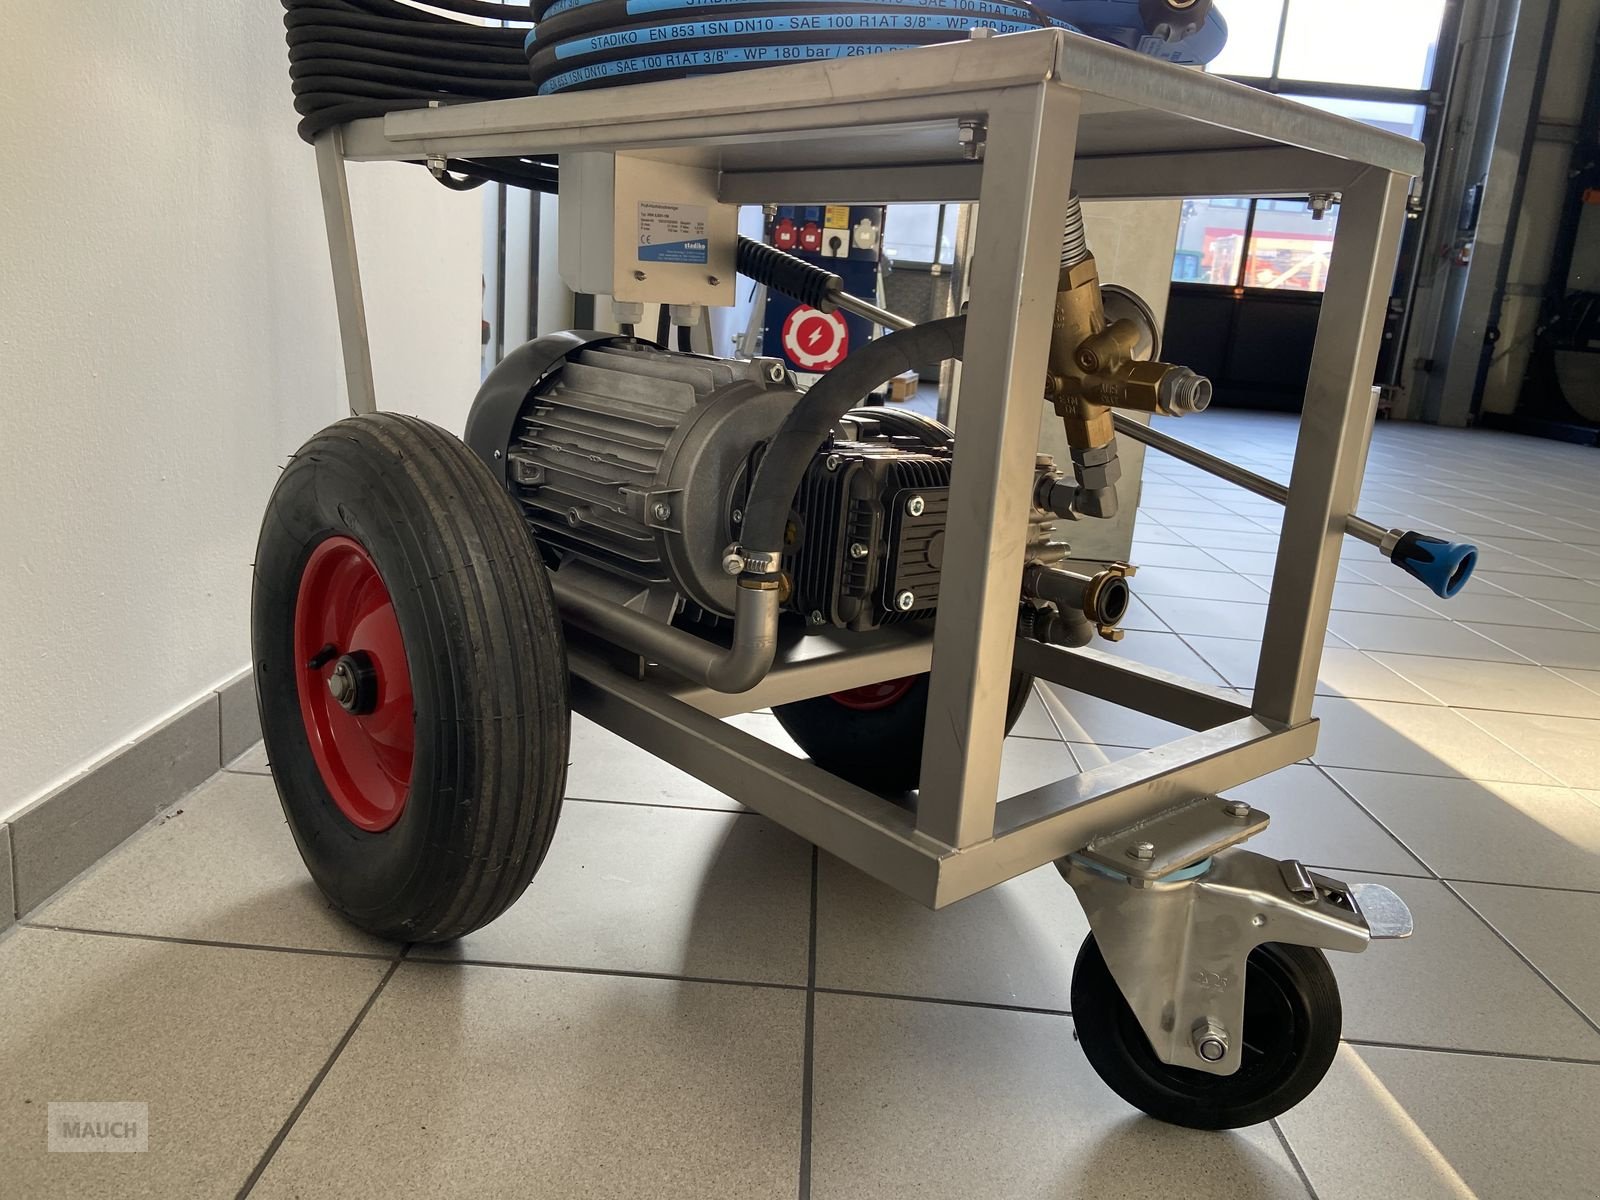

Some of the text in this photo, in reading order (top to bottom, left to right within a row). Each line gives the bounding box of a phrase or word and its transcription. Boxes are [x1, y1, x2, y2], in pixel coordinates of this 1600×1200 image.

[980, 4, 1008, 15] R1AT
[590, 31, 638, 50] STADIKO
[649, 28, 667, 41] EN
[671, 25, 695, 38] 853
[700, 22, 729, 35] 1SN
[734, 19, 774, 32] DN10
[790, 17, 820, 29] SAE
[827, 16, 854, 28] 100
[860, 15, 899, 28] R1AT
[904, 16, 932, 29] 3/8"
[946, 17, 968, 29] WP
[1000, 22, 1020, 34] bar
[584, 64, 607, 79] DN10
[617, 60, 639, 73] SAE
[643, 56, 661, 69] 100
[666, 52, 698, 66] R1AT
[703, 50, 729, 63] 3/8"
[744, 47, 767, 59] WP
[774, 46, 800, 59] 180
[806, 46, 831, 58] bar
[847, 45, 883, 57] 2610
